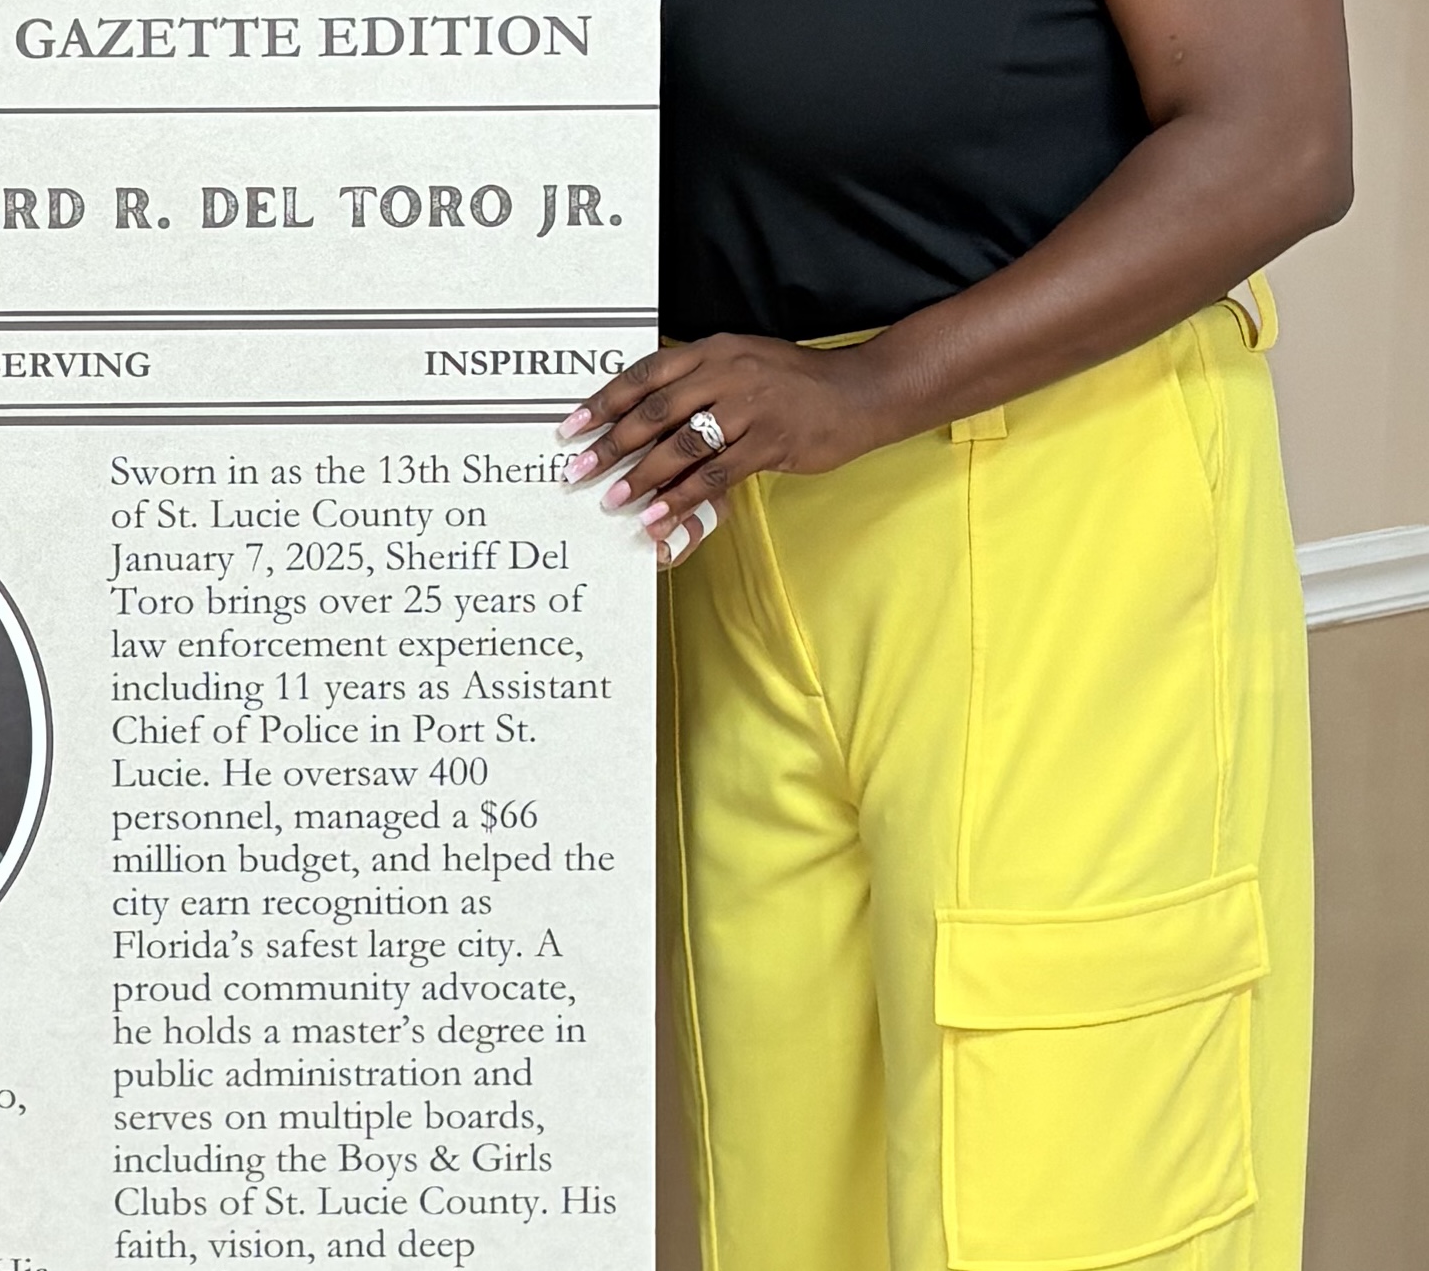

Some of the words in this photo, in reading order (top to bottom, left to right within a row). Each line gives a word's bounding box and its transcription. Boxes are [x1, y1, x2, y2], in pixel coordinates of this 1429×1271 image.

[16, 17, 300, 58] GAZETTE
[319, 16, 591, 56] EDITION
[116, 188, 170, 229] R.
[202, 187, 314, 228] DEL
[340, 185, 512, 227] TORO
[537, 185, 621, 237] JR.
[424, 349, 625, 375] INSPIRING
[112, 457, 216, 485] Sworn
[228, 456, 258, 484] in
[272, 466, 301, 484] as
[316, 455, 364, 484] the
[380, 455, 449, 483] 13th
[107, 544, 234, 581] January
[246, 543, 273, 577] 7,
[287, 542, 374, 576] 2025,
[387, 541, 500, 570] Sheriff
[509, 541, 568, 569] Del
[111, 587, 193, 614] Toro
[207, 586, 306, 624] brings
[320, 595, 392, 613] over
[404, 585, 441, 613] 25
[455, 594, 535, 622] years
[549, 584, 587, 612] of
[112, 629, 166, 657] law
[179, 628, 386, 657] enforcement
[399, 628, 583, 667] experience,
[112, 672, 264, 710] including
[278, 672, 308, 699] 11
[325, 681, 405, 709] years
[419, 681, 449, 699] as
[464, 671, 611, 699] Assistant
[113, 759, 208, 786] Lucie.
[225, 759, 271, 786] He
[284, 767, 418, 786] oversaw
[429, 757, 487, 785] 400
[113, 801, 282, 841] personnel,
[295, 800, 440, 839] managed
[453, 811, 468, 828] a
[481, 800, 537, 832] $66
[114, 844, 226, 872] million
[238, 843, 359, 882] budget,
[372, 843, 429, 871] and
[443, 843, 550, 881] helped
[565, 843, 614, 871] the
[113, 888, 169, 925] city
[182, 897, 250, 915] earn
[263, 887, 448, 925] recognition
[462, 896, 491, 914] as
[114, 930, 253, 958] Florida’s
[267, 929, 357, 958] safest
[369, 929, 445, 967] large
[459, 929, 521, 966] city.
[536, 929, 563, 956] A
[113, 972, 210, 1012] proud
[224, 973, 410, 1010] community
[422, 971, 575, 1006] advocate,
[114, 1016, 151, 1044] he
[164, 1015, 251, 1044] holds
[265, 1026, 280, 1043] a
[293, 1015, 424, 1043] master’s
[438, 1015, 543, 1052] degree
[557, 1015, 585, 1042] in
[114, 1059, 213, 1098] public
[226, 1058, 461, 1087] administration
[474, 1058, 532, 1086] and
[115, 1112, 212, 1130] serves
[226, 1111, 266, 1129] on
[280, 1101, 411, 1139] multiple
[425, 1100, 544, 1135] boards,
[114, 1144, 265, 1182] including
[277, 1144, 326, 1172] the
[338, 1144, 417, 1181] Boys
[430, 1146, 459, 1171] &
[473, 1143, 551, 1171] Girls
[117, 1230, 196, 1264] faith,
[209, 1230, 314, 1263] vision,
[328, 1229, 385, 1257] and
[399, 1229, 474, 1267] deep
